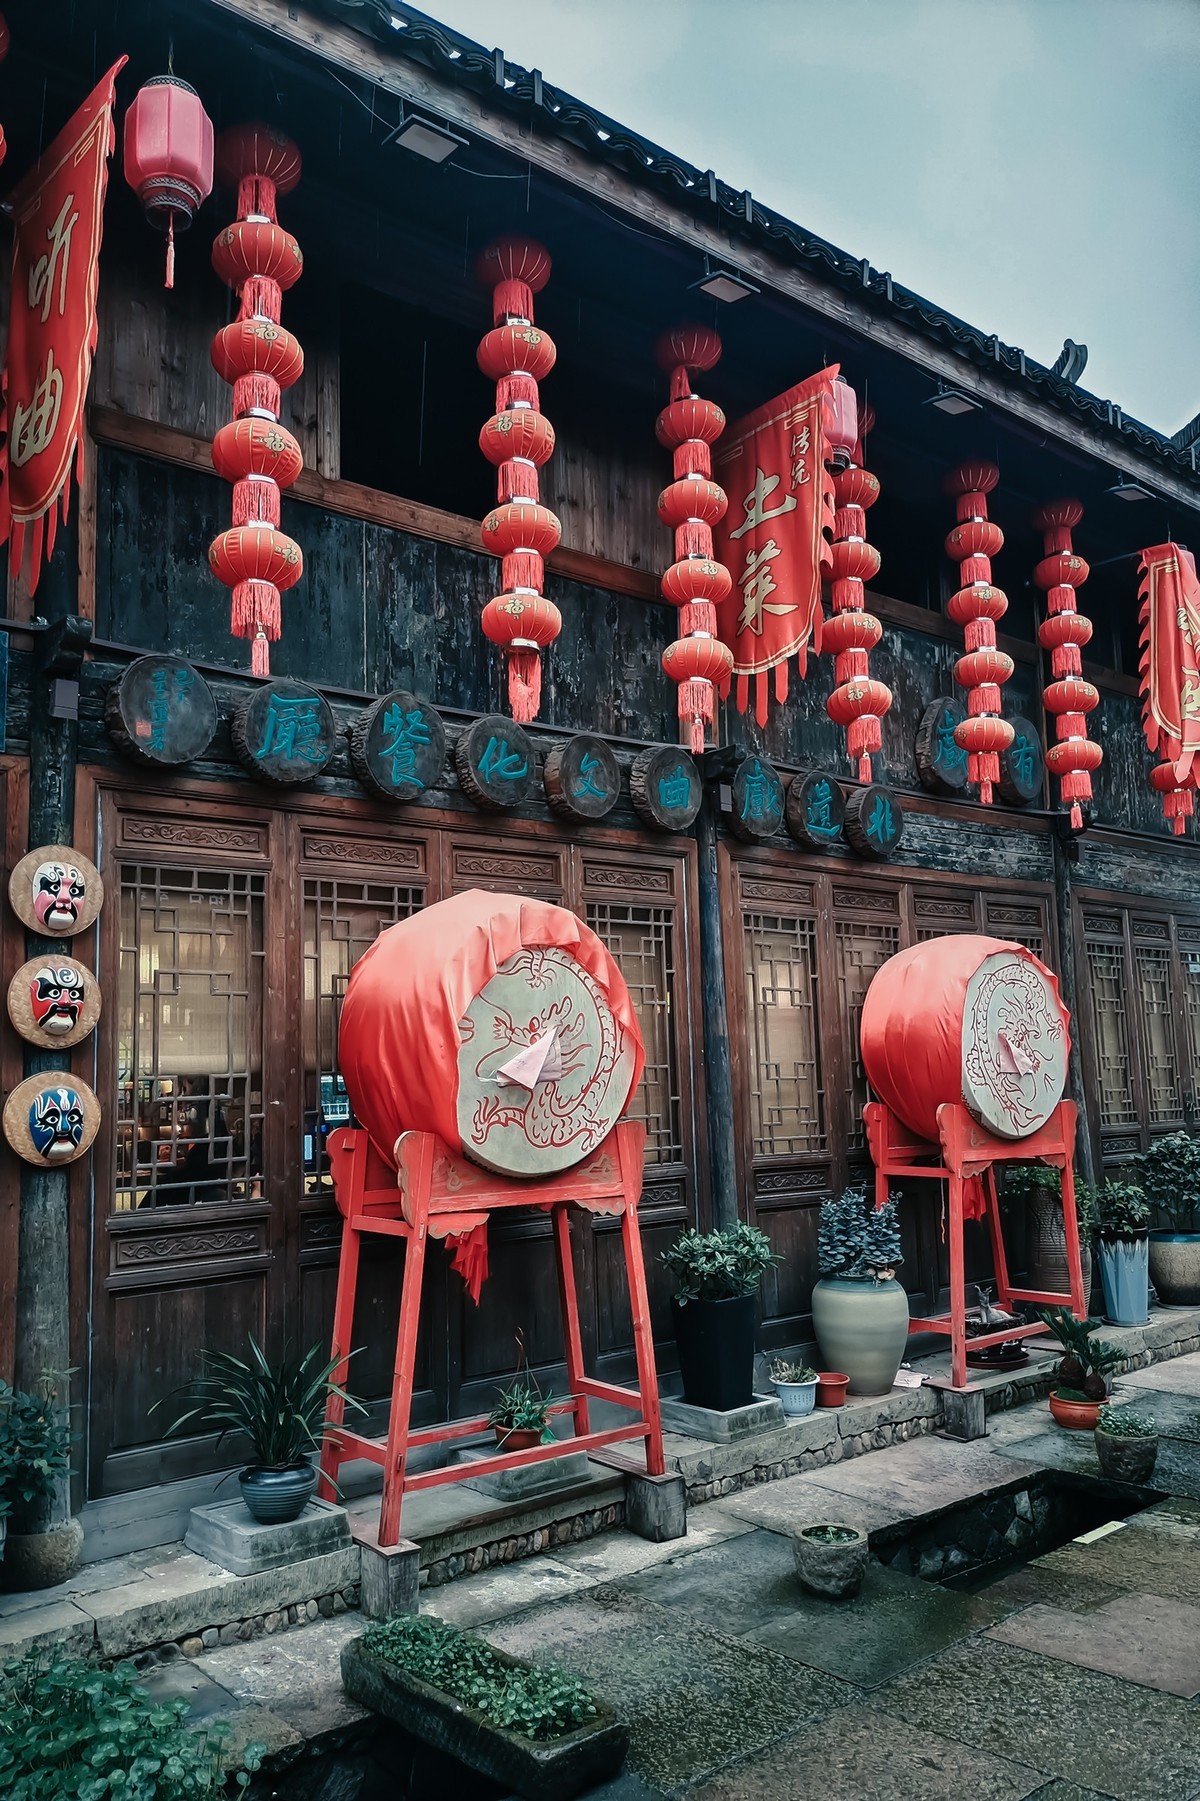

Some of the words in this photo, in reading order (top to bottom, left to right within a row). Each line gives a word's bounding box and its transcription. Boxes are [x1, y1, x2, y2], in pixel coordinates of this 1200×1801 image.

[9, 193, 79, 469] 听曲
[254, 323, 279, 341] 福
[522, 328, 543, 346] 福
[496, 414, 514, 434] 福
[263, 431, 286, 453] 福
[729, 467, 799, 637] 土菜
[504, 598, 526, 615] 福
[863, 616, 876, 630] 福
[848, 687, 864, 701] 福
